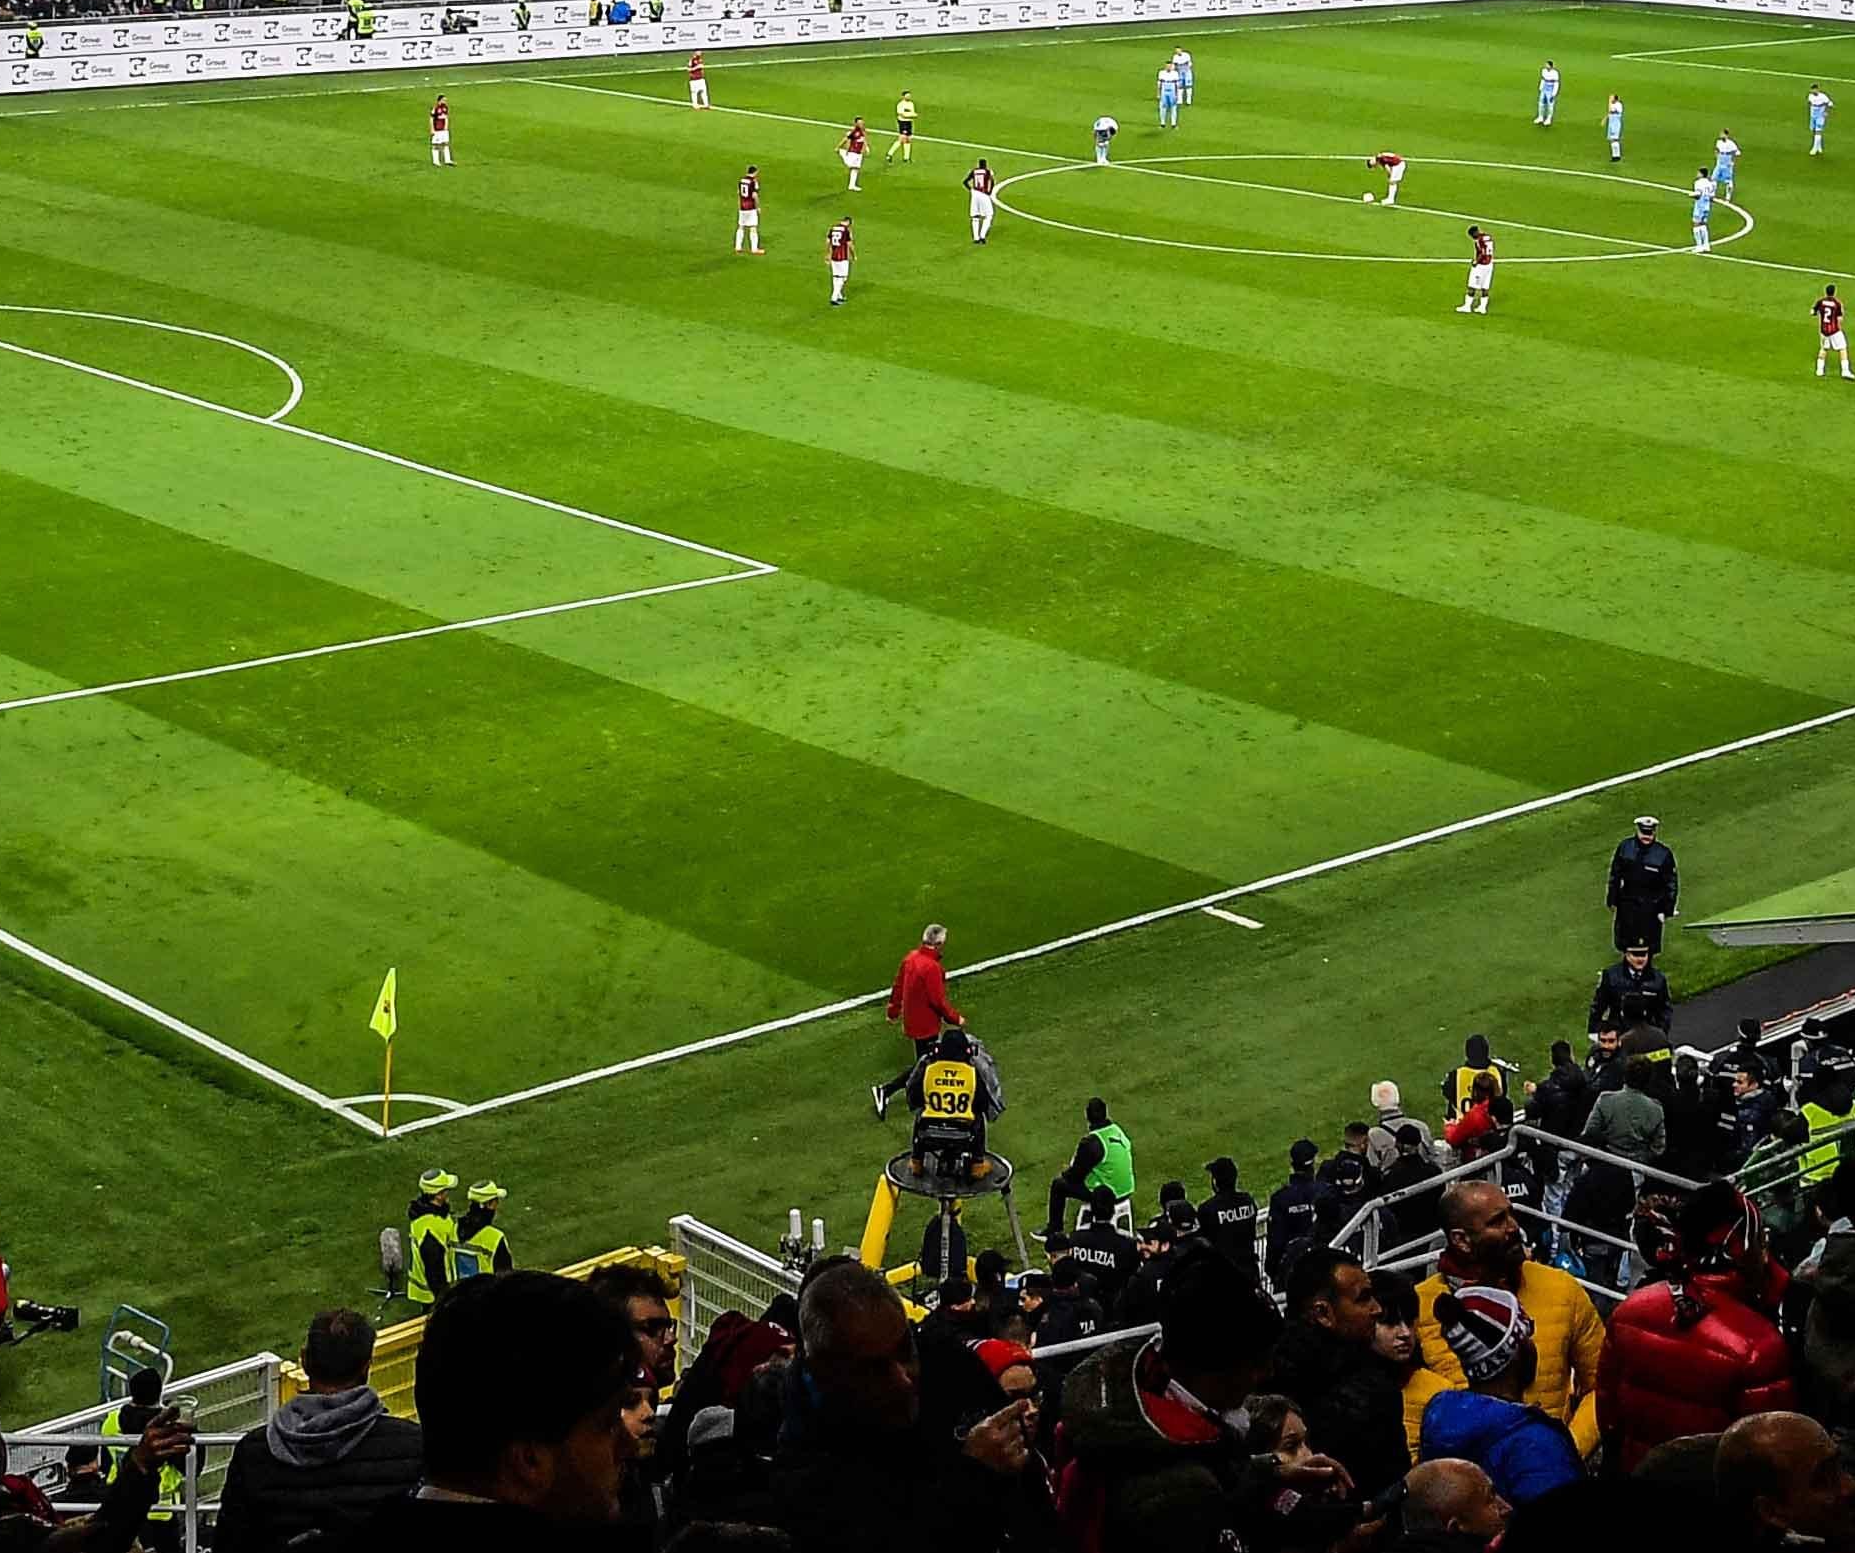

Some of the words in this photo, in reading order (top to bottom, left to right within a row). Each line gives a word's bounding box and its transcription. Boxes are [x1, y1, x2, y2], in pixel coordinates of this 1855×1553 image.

[944, 1069, 958, 1078] TV
[934, 1078, 966, 1088] CREW
[928, 1091, 972, 1116] 038
[1073, 1244, 1116, 1269] POLIZIA
